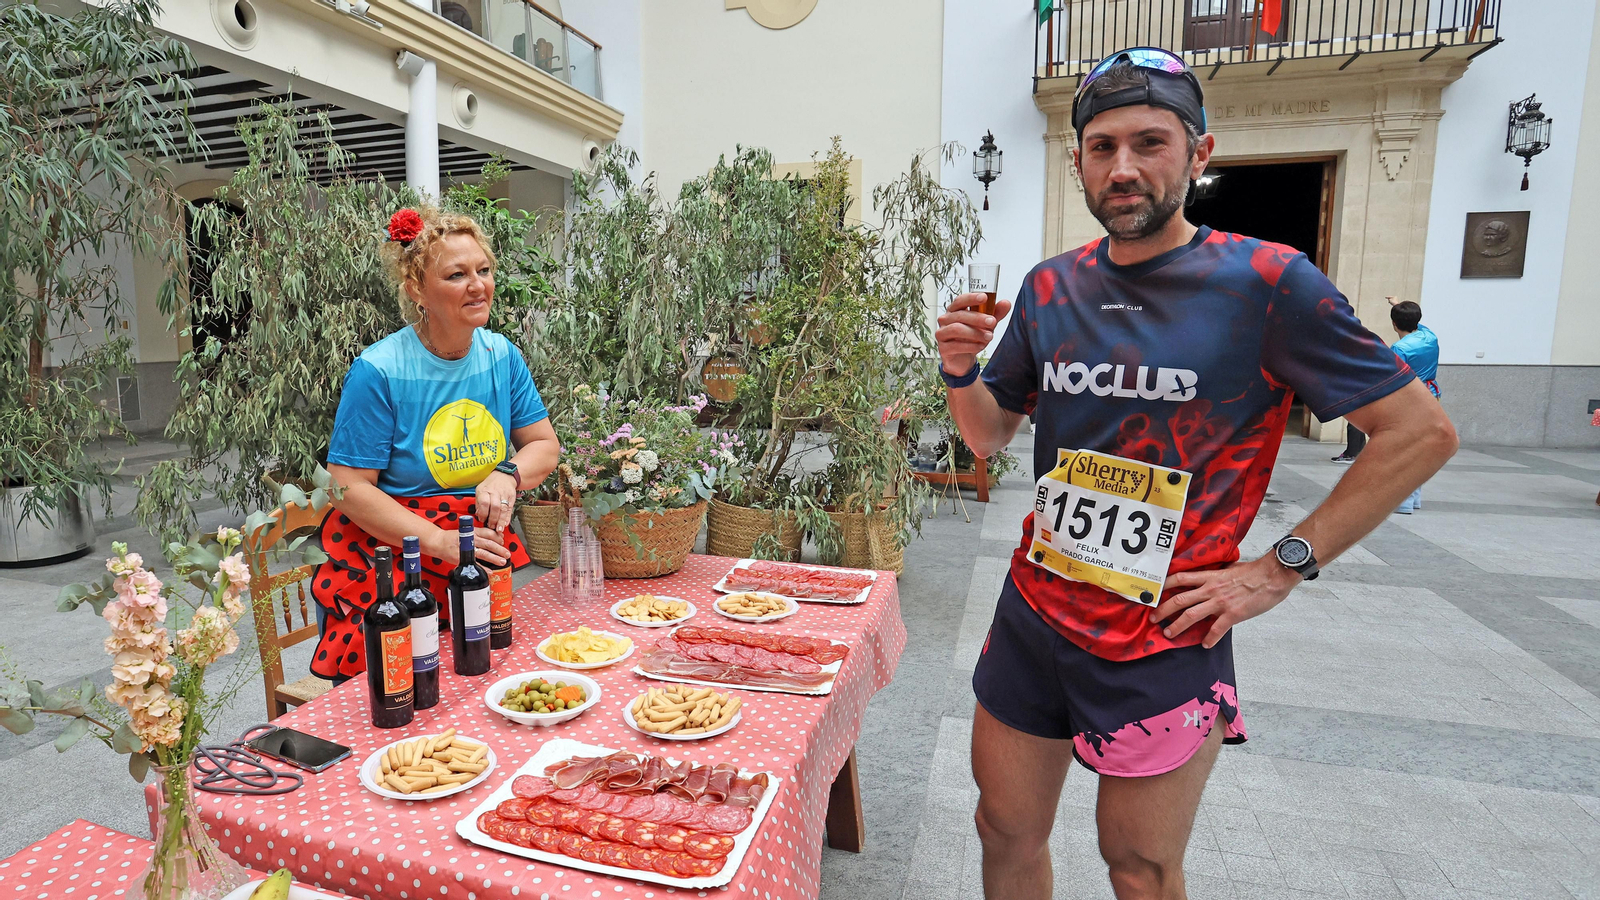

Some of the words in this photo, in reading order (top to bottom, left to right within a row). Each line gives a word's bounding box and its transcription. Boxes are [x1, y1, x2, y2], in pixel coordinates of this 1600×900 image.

[1214, 105, 1236, 120] DE
[1270, 99, 1331, 116] MADRE
[1043, 361, 1199, 402] NOCLUB
[433, 439, 499, 464] Sherry
[448, 455, 493, 472] Maraton
[1075, 456, 1146, 494] Sherry
[1093, 478, 1129, 495] Media
[1052, 491, 1151, 555] 1513
[1061, 547, 1083, 561] PRADO
[1084, 555, 1114, 570] GARCIA
[1076, 542, 1100, 555] FELIX
